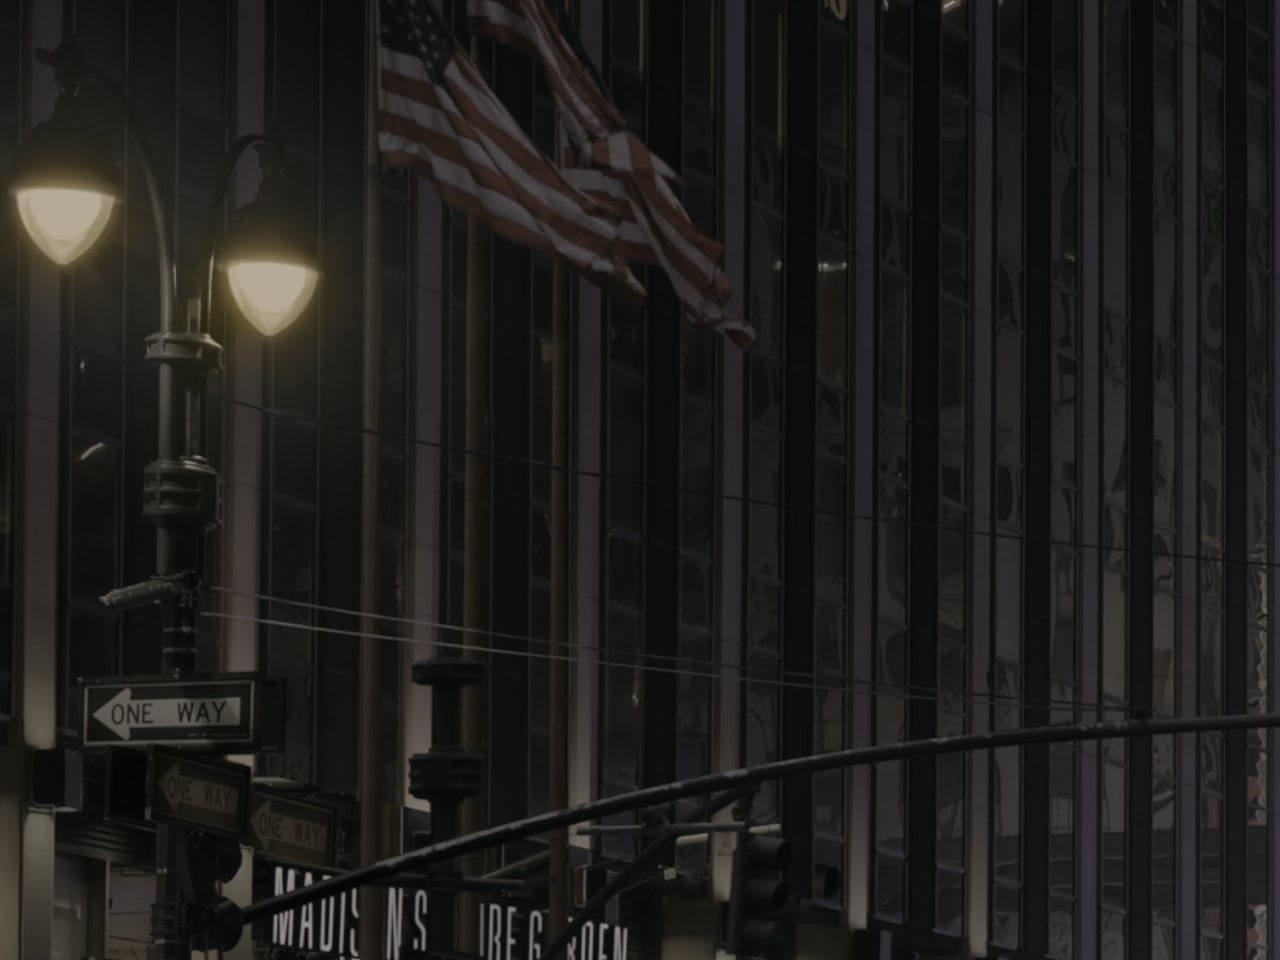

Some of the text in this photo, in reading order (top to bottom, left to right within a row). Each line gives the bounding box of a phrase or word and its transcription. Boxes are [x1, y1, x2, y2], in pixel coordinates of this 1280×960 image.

[111, 701, 228, 725] ONE WAY
[167, 775, 234, 809] ONE WAY
[258, 814, 322, 848] ONE WAY
